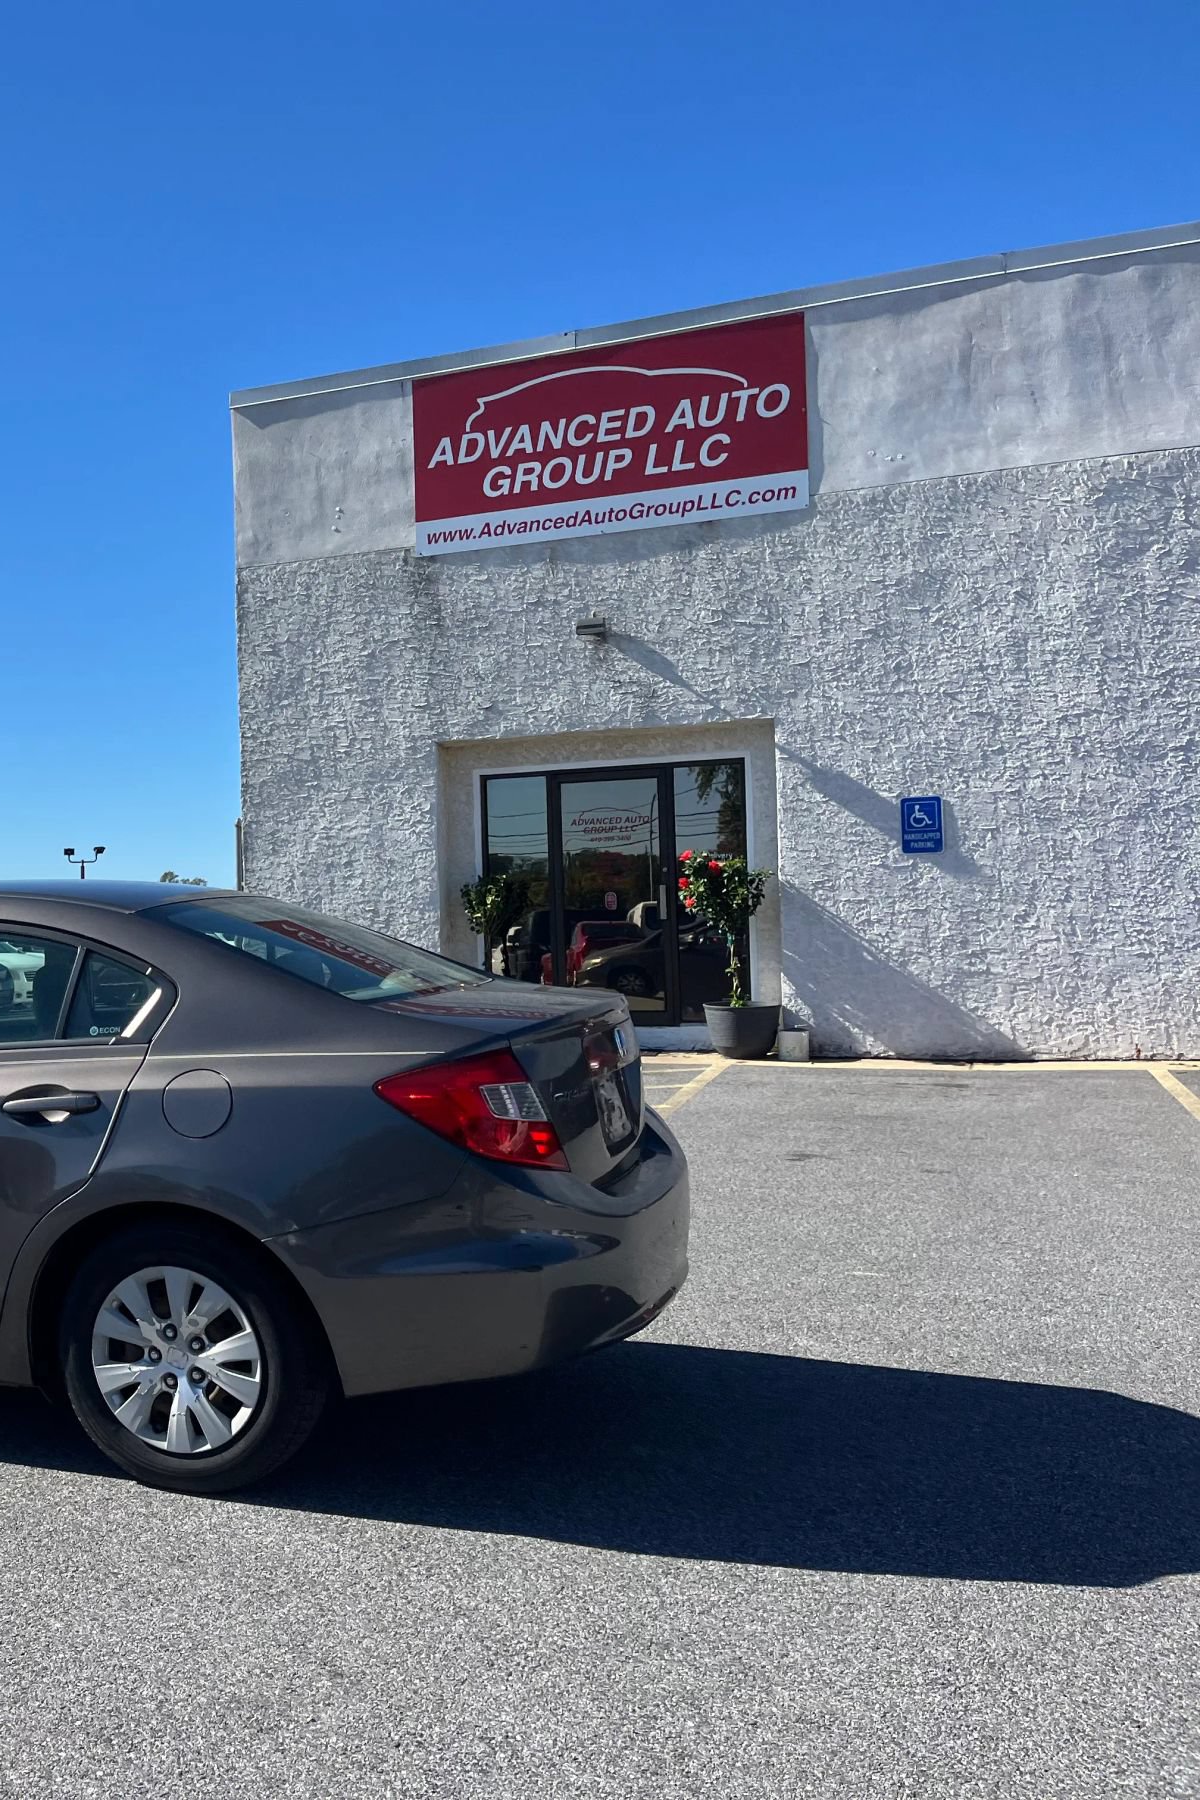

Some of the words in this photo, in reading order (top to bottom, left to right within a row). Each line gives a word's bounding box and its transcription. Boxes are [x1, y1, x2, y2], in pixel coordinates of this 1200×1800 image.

[428, 405, 656, 468] ADVANCED
[665, 384, 791, 433] AUTO
[482, 449, 633, 498] GROUP
[645, 434, 731, 476] LLC
[427, 485, 797, 545] www.AdvancedAutoGroupLLC.com
[571, 816, 622, 826] ADVANCED
[624, 815, 650, 824] AUTO
[583, 826, 617, 834] GROUP
[619, 825, 638, 833] LLC
[904, 832, 940, 840] HANDICAPPED
